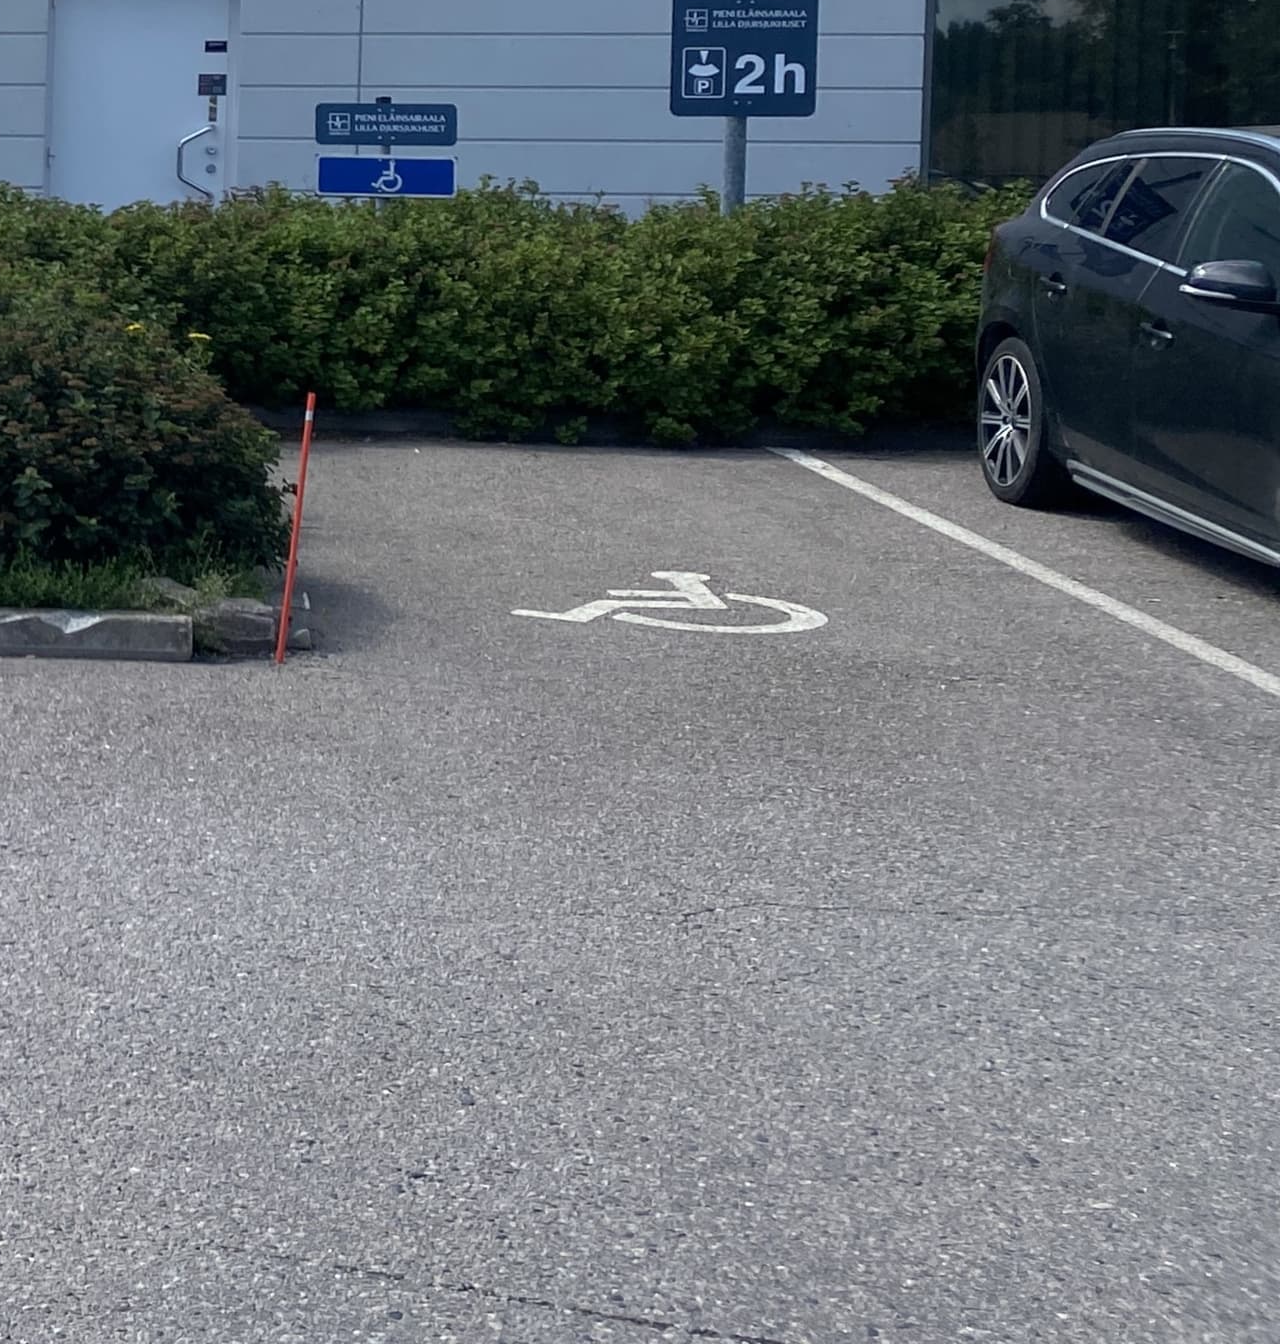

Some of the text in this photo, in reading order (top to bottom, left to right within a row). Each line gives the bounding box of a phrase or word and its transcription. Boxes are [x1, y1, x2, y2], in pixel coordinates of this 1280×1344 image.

[712, 9, 736, 19] PIENI
[712, 19, 736, 29] LILLA
[697, 80, 710, 94] P
[354, 113, 377, 123] PIENI
[354, 124, 378, 133] LILLA
